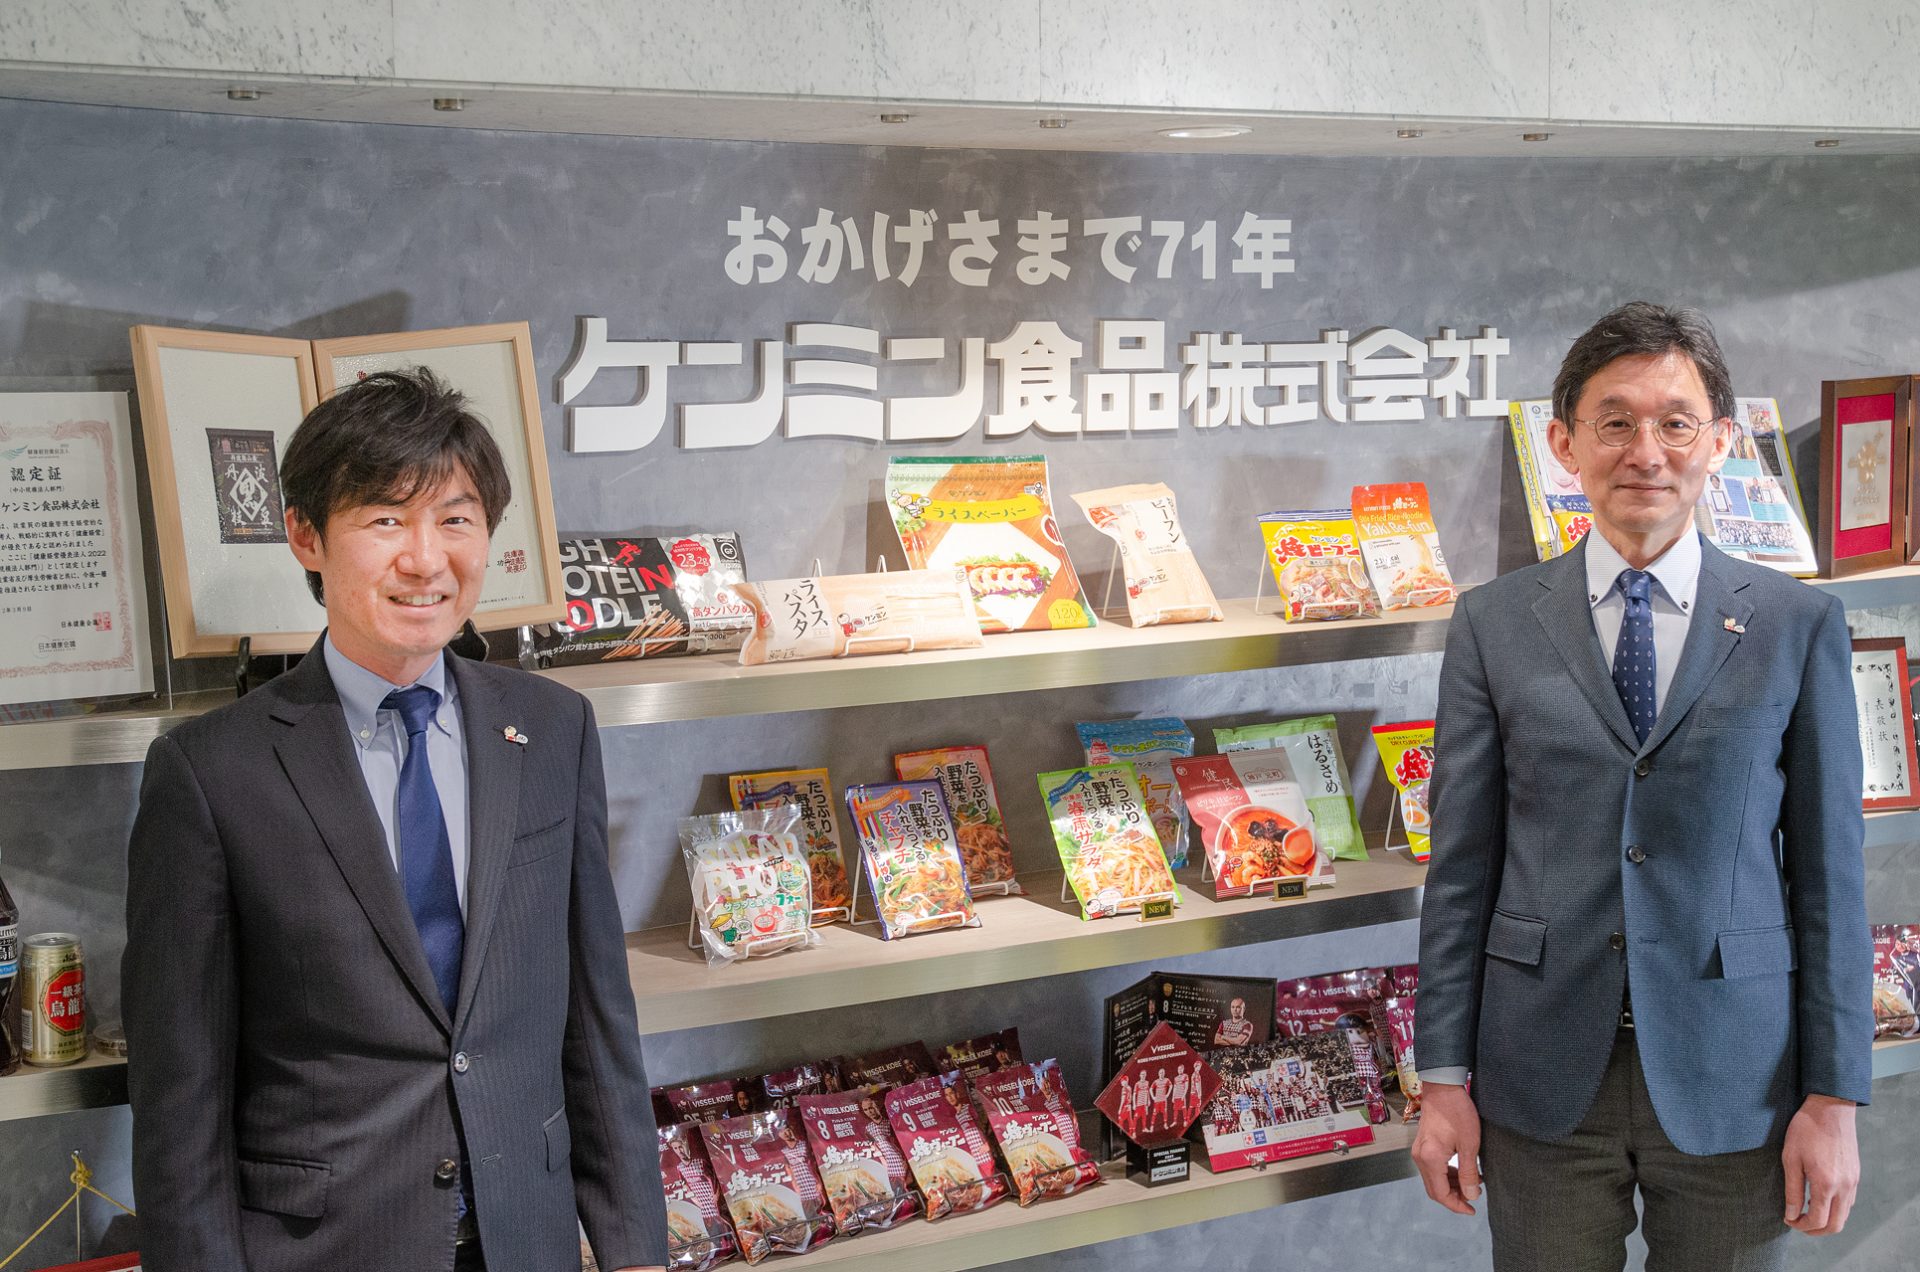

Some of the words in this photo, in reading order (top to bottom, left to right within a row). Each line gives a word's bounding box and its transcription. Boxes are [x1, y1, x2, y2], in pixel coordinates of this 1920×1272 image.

[724, 205, 1295, 289] おかげさまで71年
[555, 315, 1510, 453] ケンミン食品株式会社
[10, 465, 63, 482] 認定証
[1, 498, 101, 513] ケンミン食品株式会社
[933, 507, 1027, 520] ライスペーパー
[1151, 499, 1180, 543] ビーフン
[1362, 522, 1392, 536] Yaki
[1273, 536, 1361, 565] 焼ビーフン
[799, 579, 829, 626] ライス
[784, 589, 808, 640] パスタ
[864, 610, 887, 621] ケンミン
[1307, 734, 1338, 794] はるさめ
[1079, 783, 1104, 829] 入れてつくる
[1091, 781, 1117, 817] 野菜を
[909, 803, 932, 838] 野菜を
[896, 804, 926, 861] 入れてつくる
[1067, 801, 1103, 869] 春雨サラダ
[1281, 885, 1300, 894] NEW
[1148, 904, 1168, 914] NEW
[1322, 987, 1344, 996] VISSEL
[1163, 1000, 1169, 1013] 8
[1295, 1009, 1317, 1017] VISSEL
[1288, 1019, 1307, 1037] 12
[976, 1048, 993, 1058] KOBE
[863, 1065, 887, 1078] VISSEL
[886, 1060, 903, 1070] KOBE
[996, 1082, 1019, 1093] VISSEL
[1019, 1077, 1035, 1087] OBE
[691, 1095, 718, 1107] VISSEL
[716, 1094, 735, 1103] KOBE
[904, 1095, 926, 1107] VISSEL
[925, 1090, 941, 1101] KOBE
[993, 1097, 1014, 1117] 10
[840, 1104, 860, 1113] KOBE
[817, 1120, 831, 1140] 8
[902, 1112, 917, 1132] 9
[728, 1130, 753, 1140] VISSEL
[723, 1144, 736, 1165] 7
